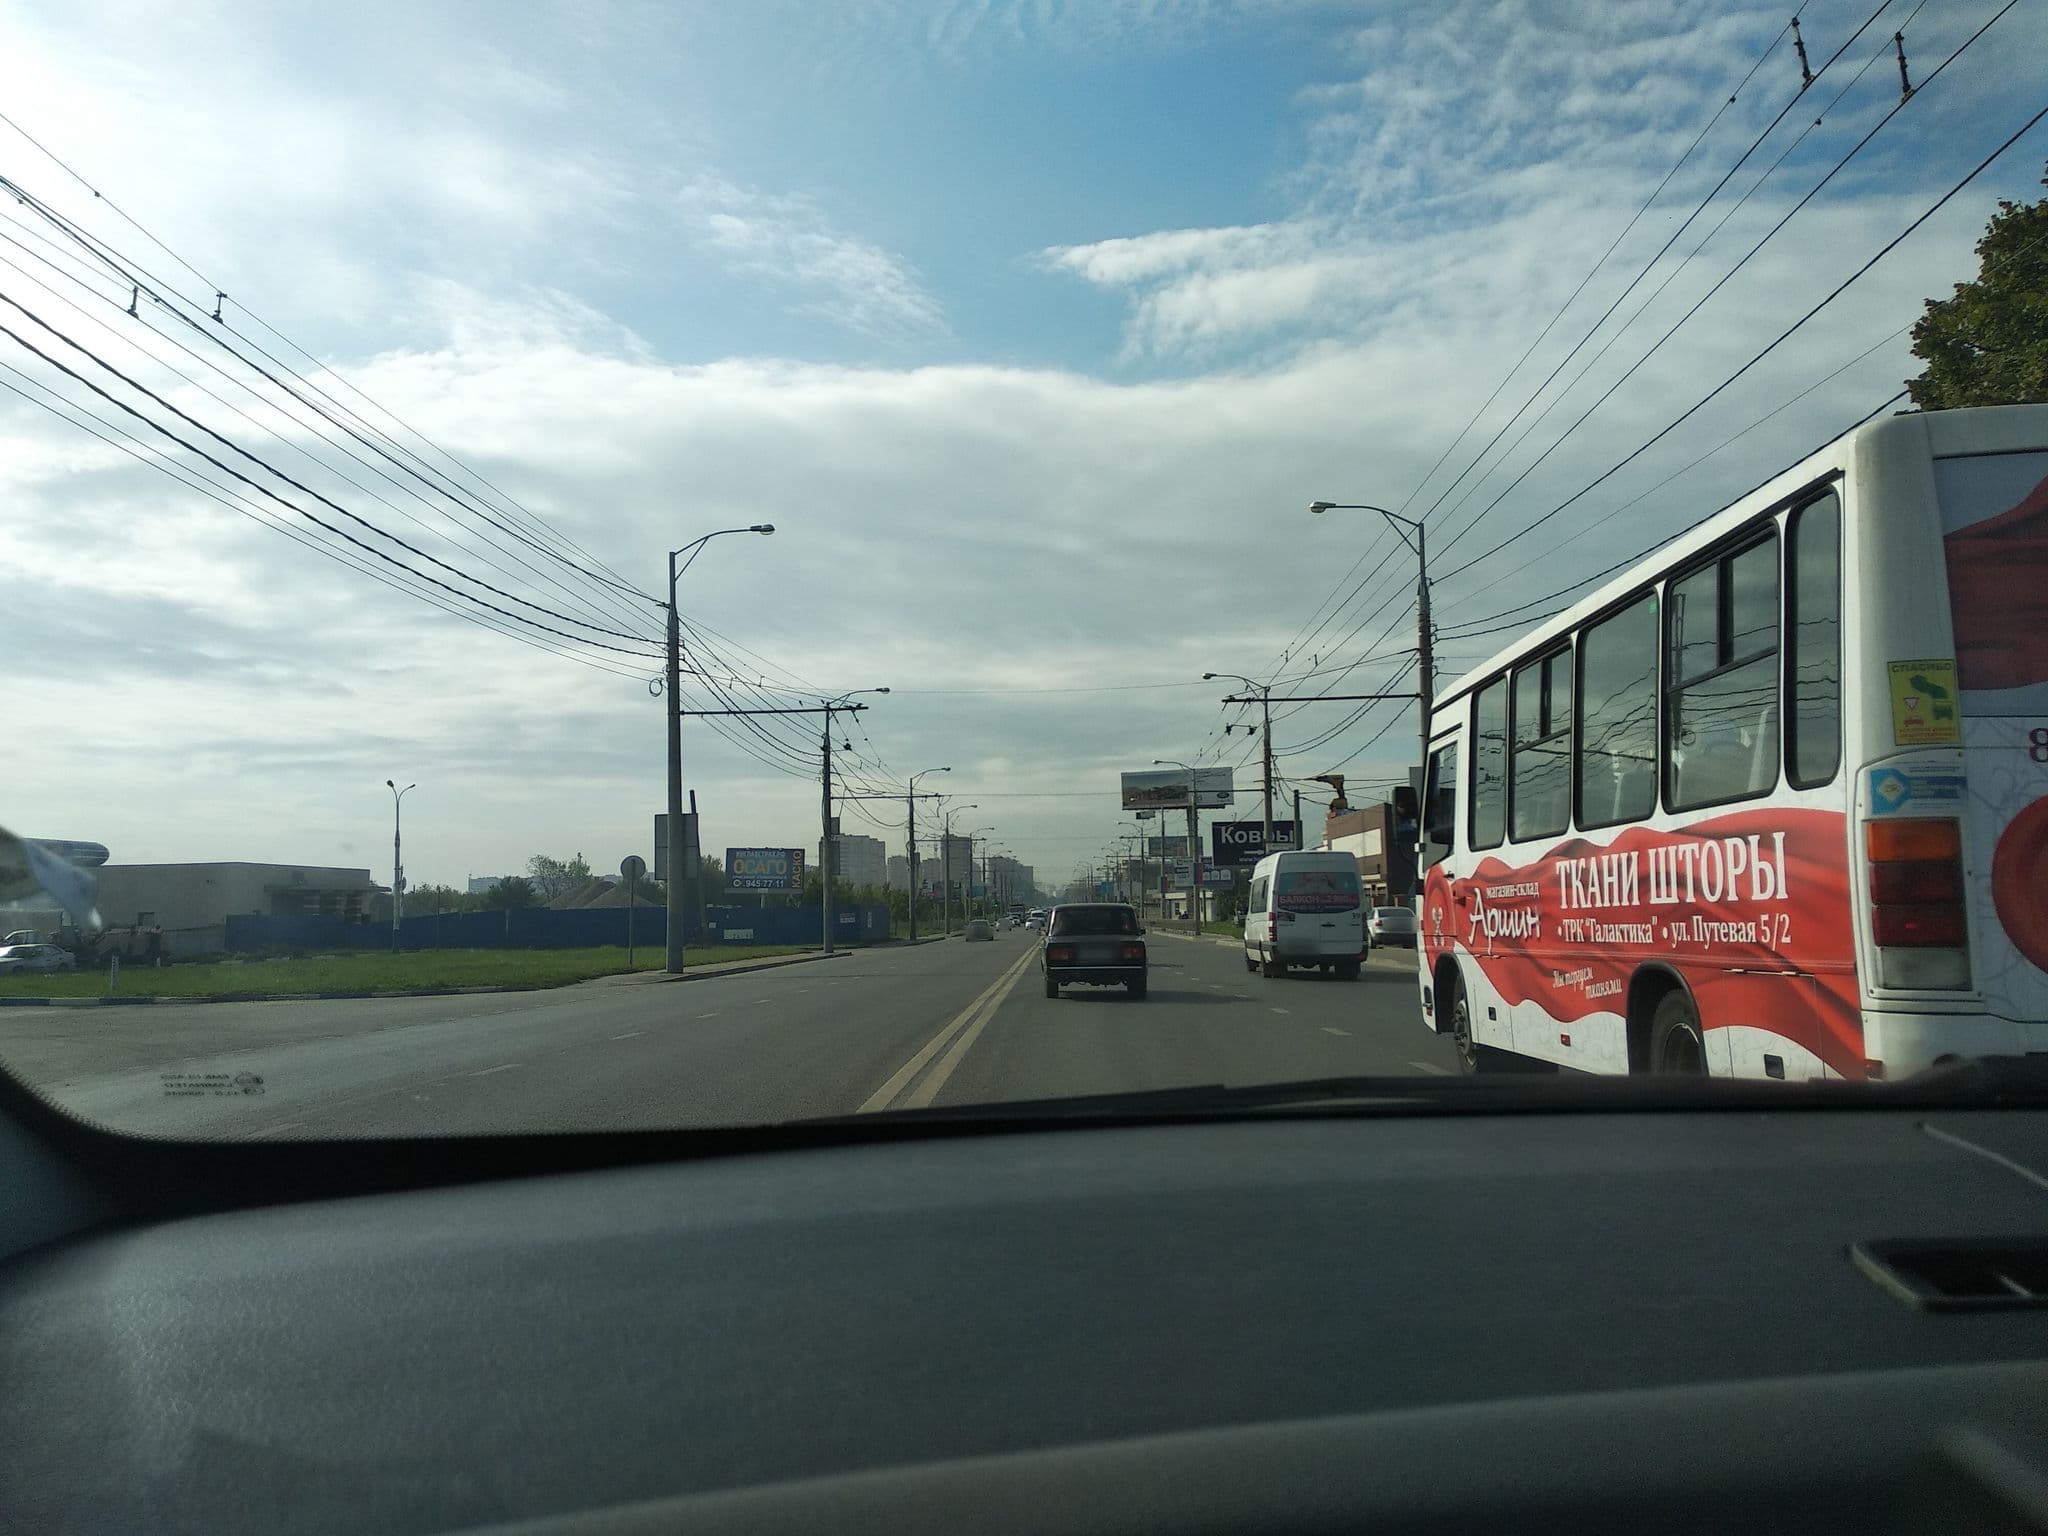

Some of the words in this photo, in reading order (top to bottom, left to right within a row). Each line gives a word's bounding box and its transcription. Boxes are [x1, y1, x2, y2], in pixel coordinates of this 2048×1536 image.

[1891, 662, 1953, 673] СПАСИБО
[733, 859, 788, 875] ОСАГО
[791, 850, 801, 889] КАСКО
[1555, 851, 1641, 909] ТКАНИ
[1648, 831, 1788, 904] ШТОРЫ
[1486, 882, 1539, 899] магазин-склад
[1468, 887, 1540, 955] Аршин
[1671, 921, 1690, 948] ул.
[1692, 915, 1756, 949] Путевая
[1760, 913, 1791, 951] 5/2
